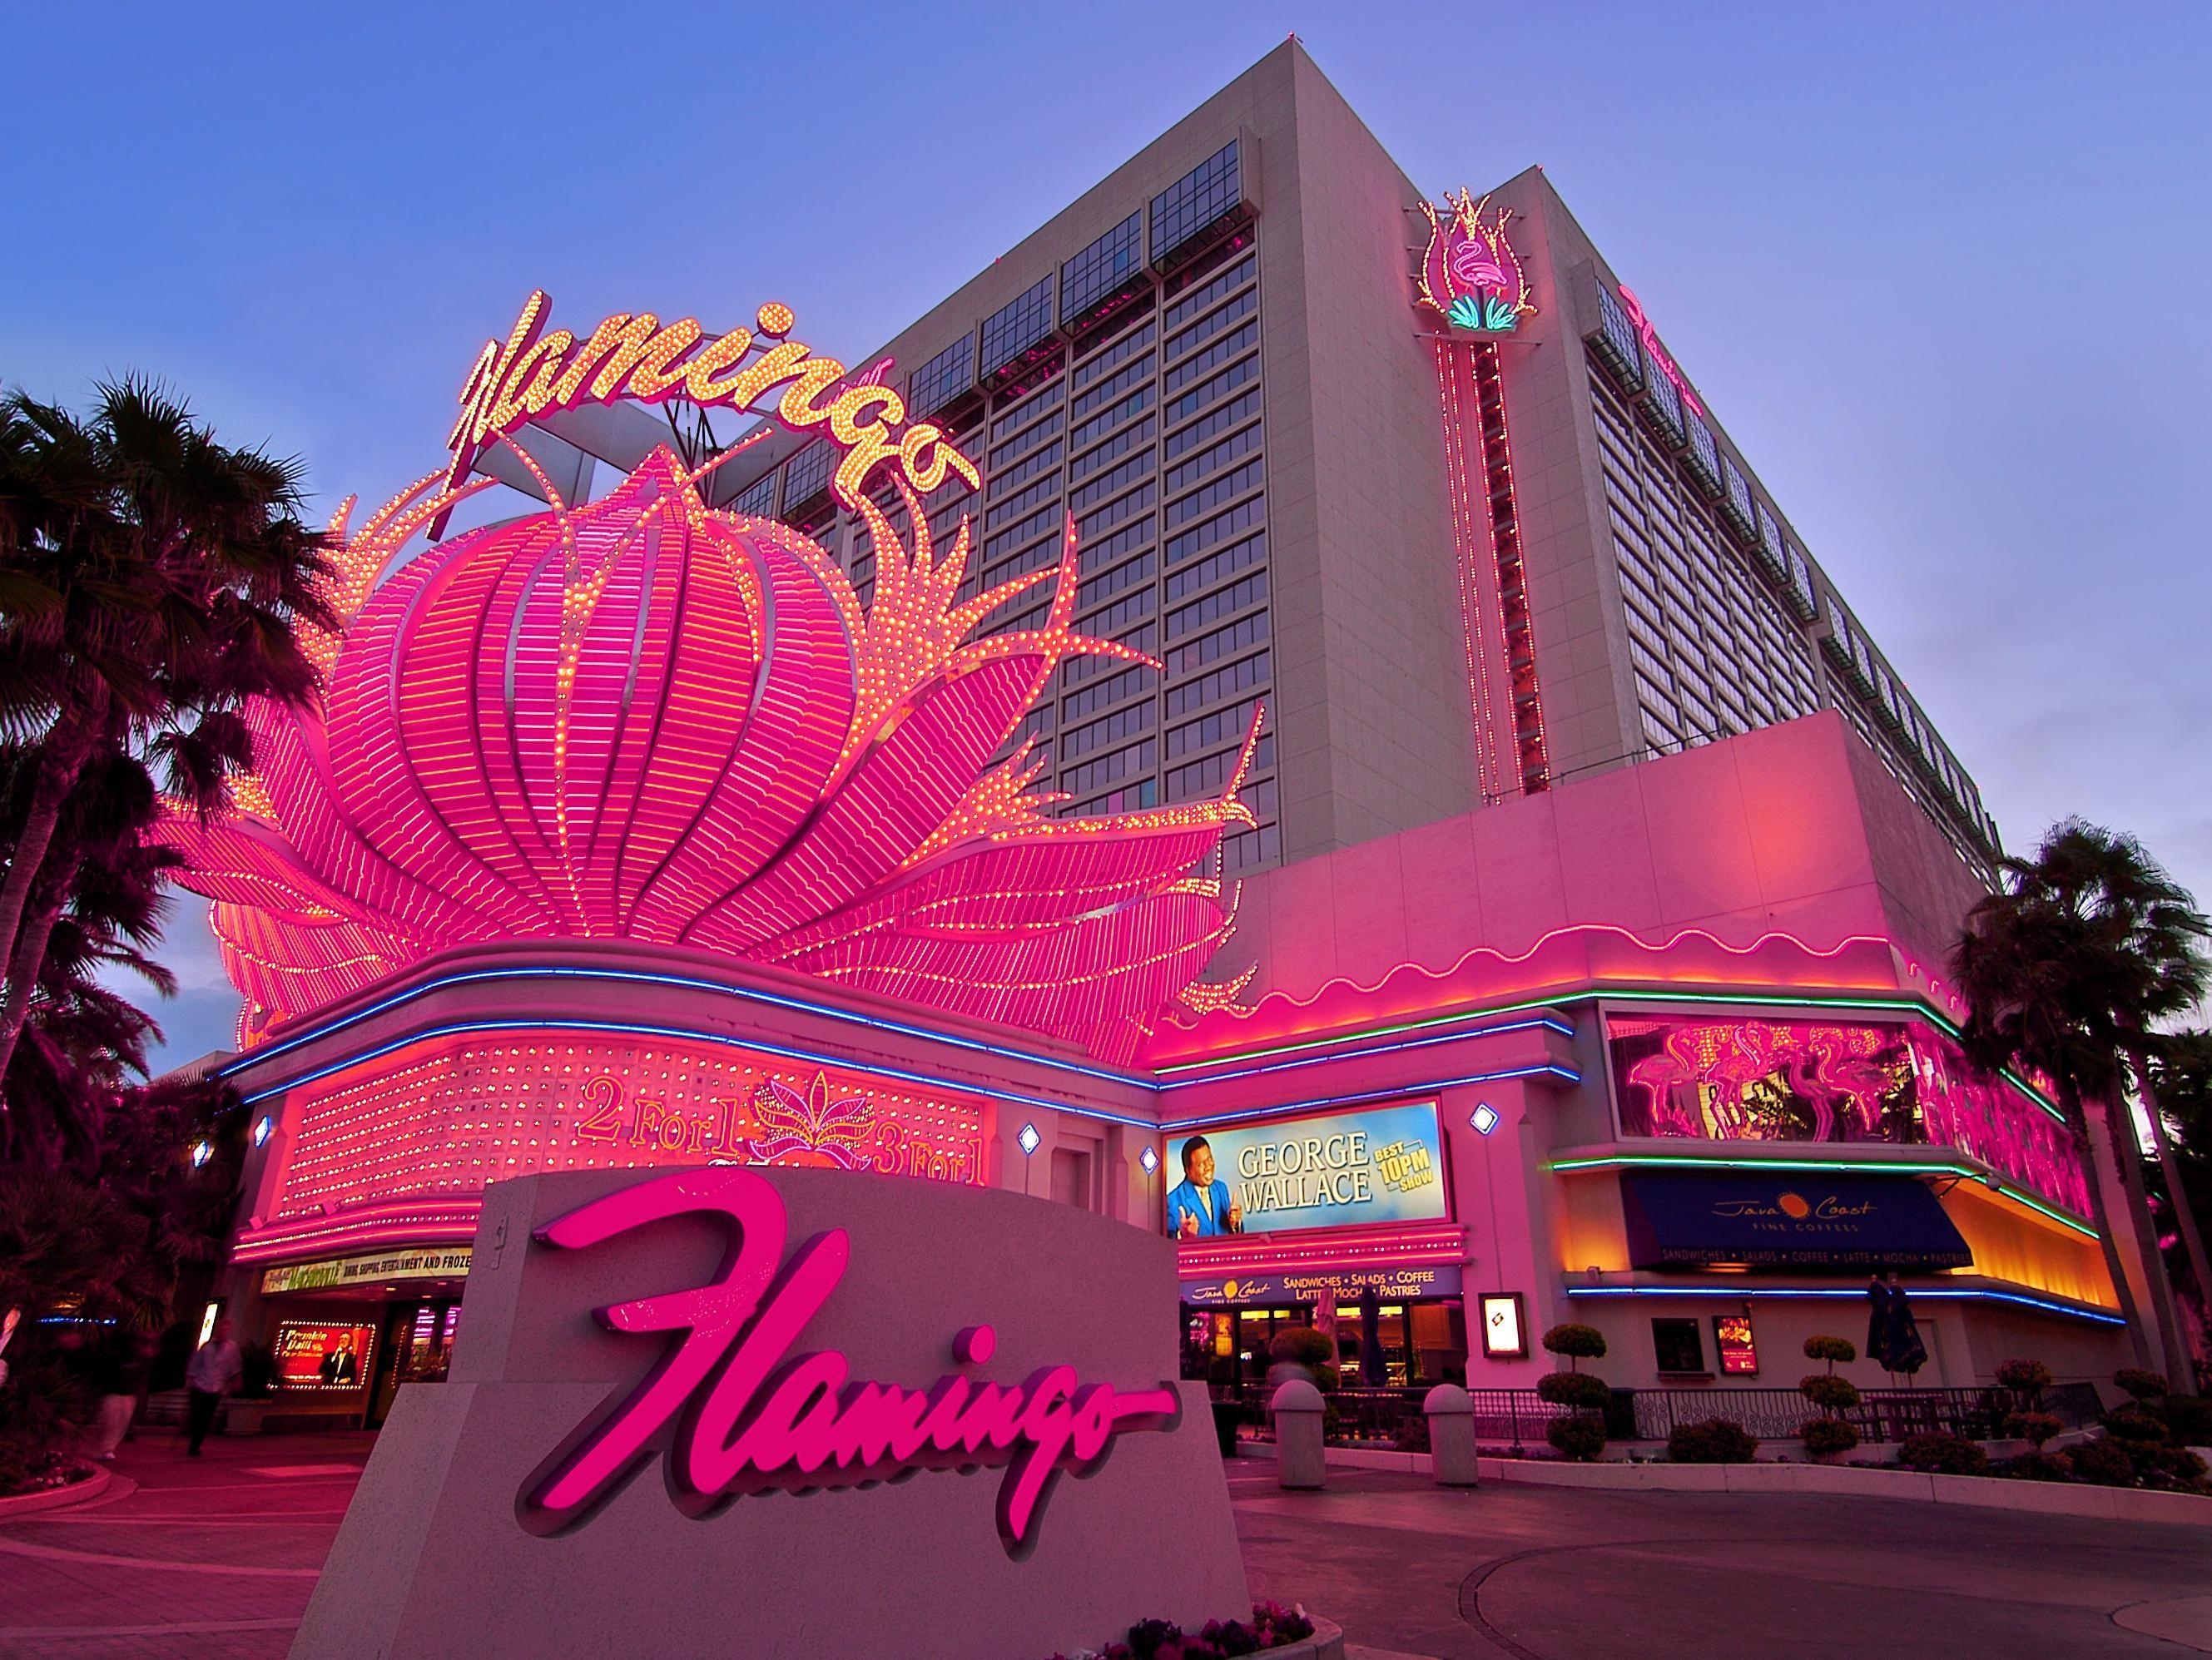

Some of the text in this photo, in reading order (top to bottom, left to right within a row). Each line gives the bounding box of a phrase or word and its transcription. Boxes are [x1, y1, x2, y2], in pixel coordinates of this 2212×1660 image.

[426, 289, 980, 541] Flamingo
[578, 1075, 623, 1140] 2
[872, 1122, 905, 1174] 3
[1237, 1132, 1370, 1178] GEORGE
[1374, 1141, 1404, 1162] BEST
[1378, 1147, 1431, 1185] 10PM
[1239, 1169, 1372, 1213] WALLACE
[1399, 1171, 1433, 1192] SHOW
[1711, 1196, 1877, 1219] Java Coast
[1753, 1223, 1860, 1231] FINE COFFEES
[424, 1256, 440, 1269] AND
[1663, 1249, 1971, 1264] SANDWICHES SALADS COFFEE LATTE MOCHA PASTRIES
[1192, 1280, 1271, 1300] Java Coast
[1283, 1276, 1342, 1289] SANDWICHES
[1396, 1271, 1435, 1284] COFFEE
[1332, 1287, 1363, 1299] MOCH
[1379, 1285, 1421, 1297] PASTRIES
[524, 1166, 1178, 1548] Flamingo
